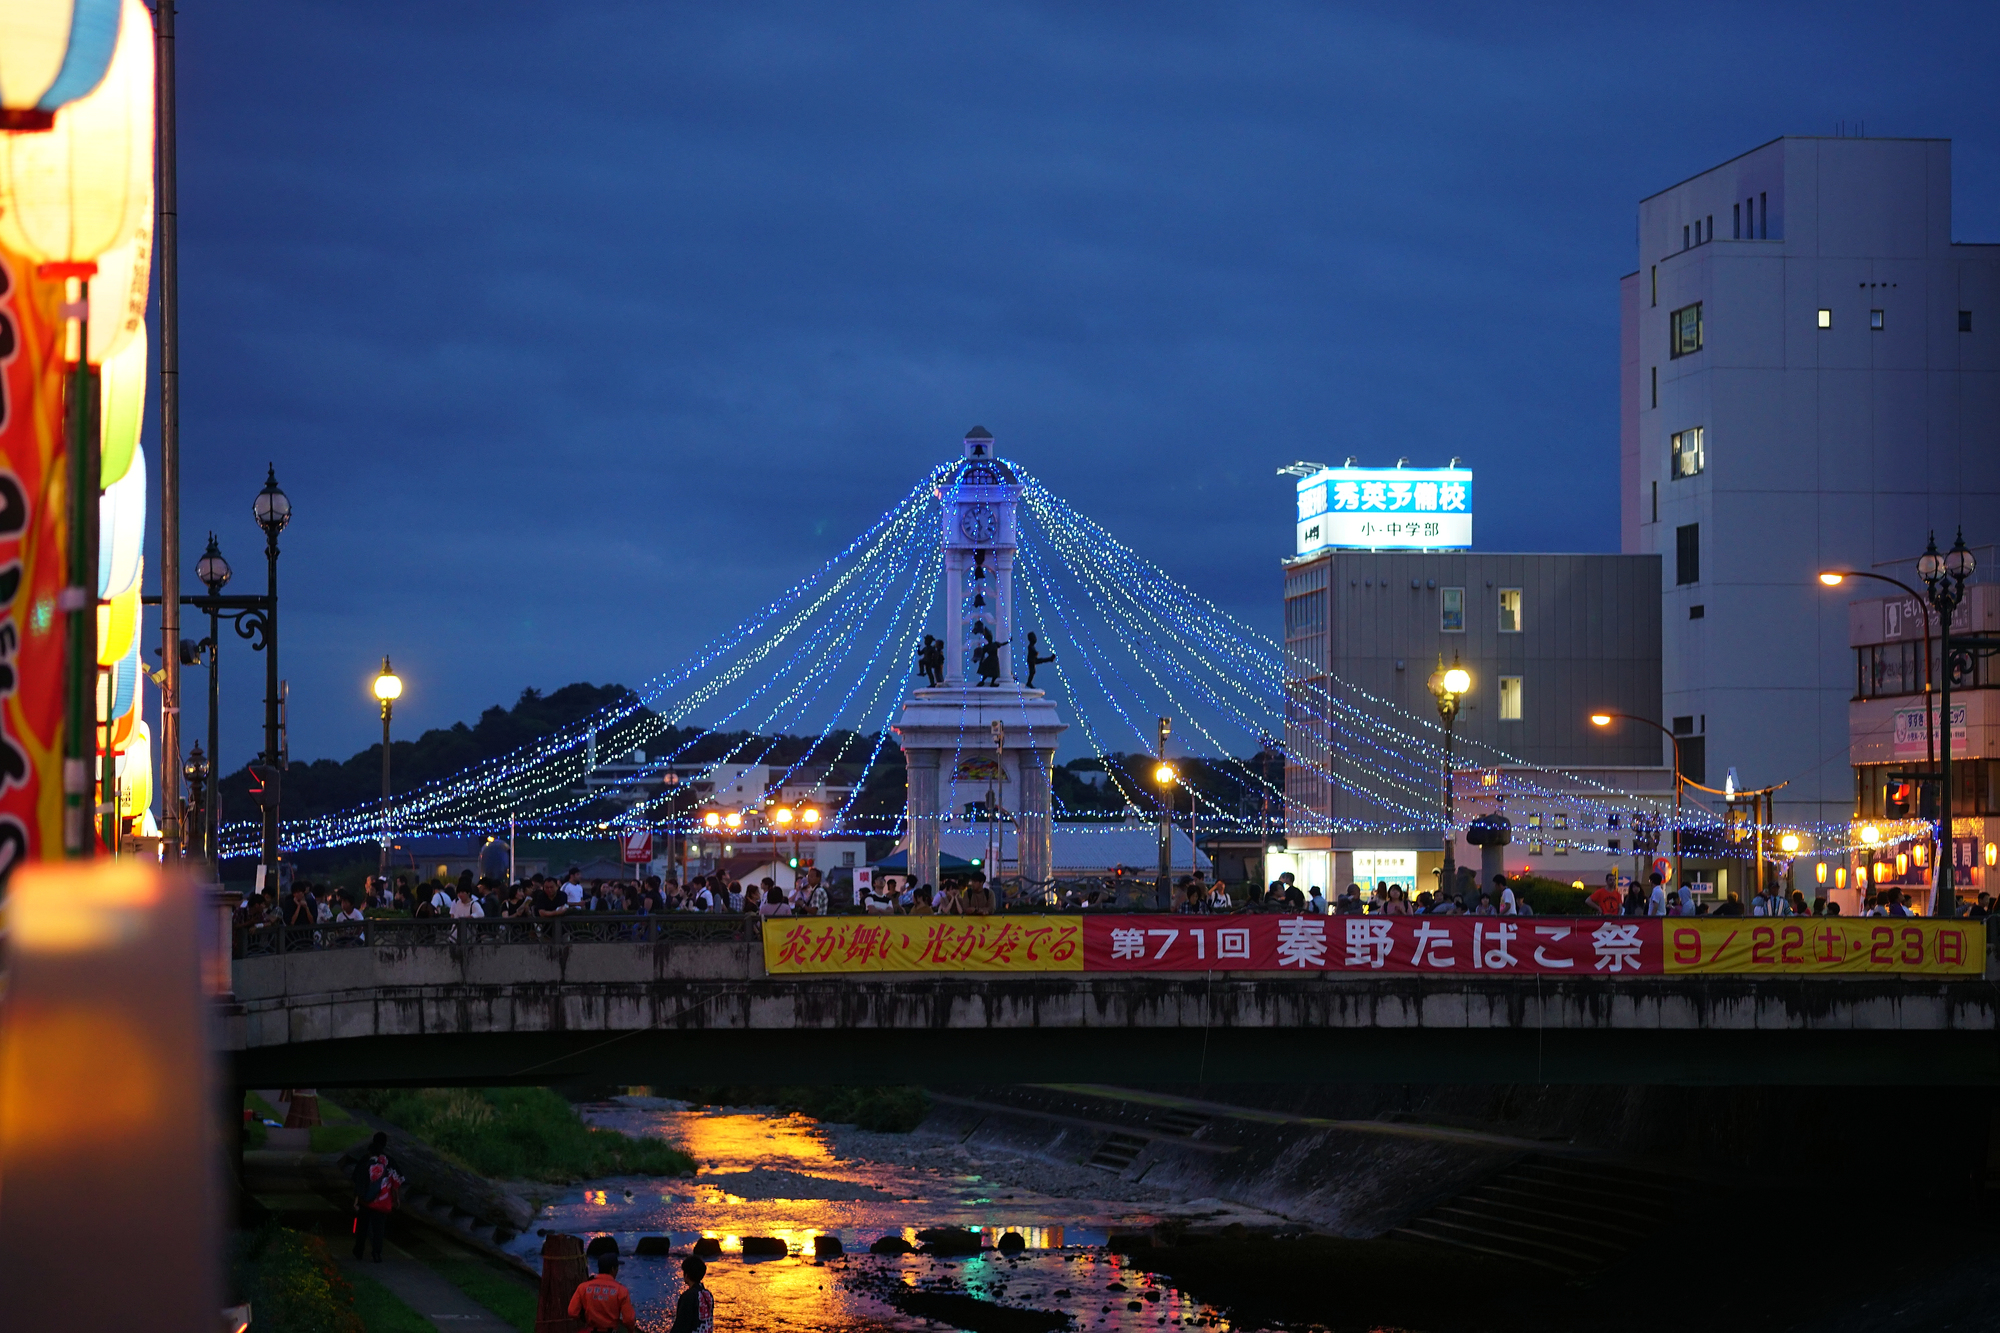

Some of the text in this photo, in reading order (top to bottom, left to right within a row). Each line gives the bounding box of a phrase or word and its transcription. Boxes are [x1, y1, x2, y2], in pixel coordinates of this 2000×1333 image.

[1333, 481, 1466, 511] 秀英予備校
[1361, 522, 1440, 537] 小・中学部
[777, 922, 1078, 966] 炎が舞い 光が奏でる
[1110, 916, 1643, 972] 第71回 秦野たばこ祭
